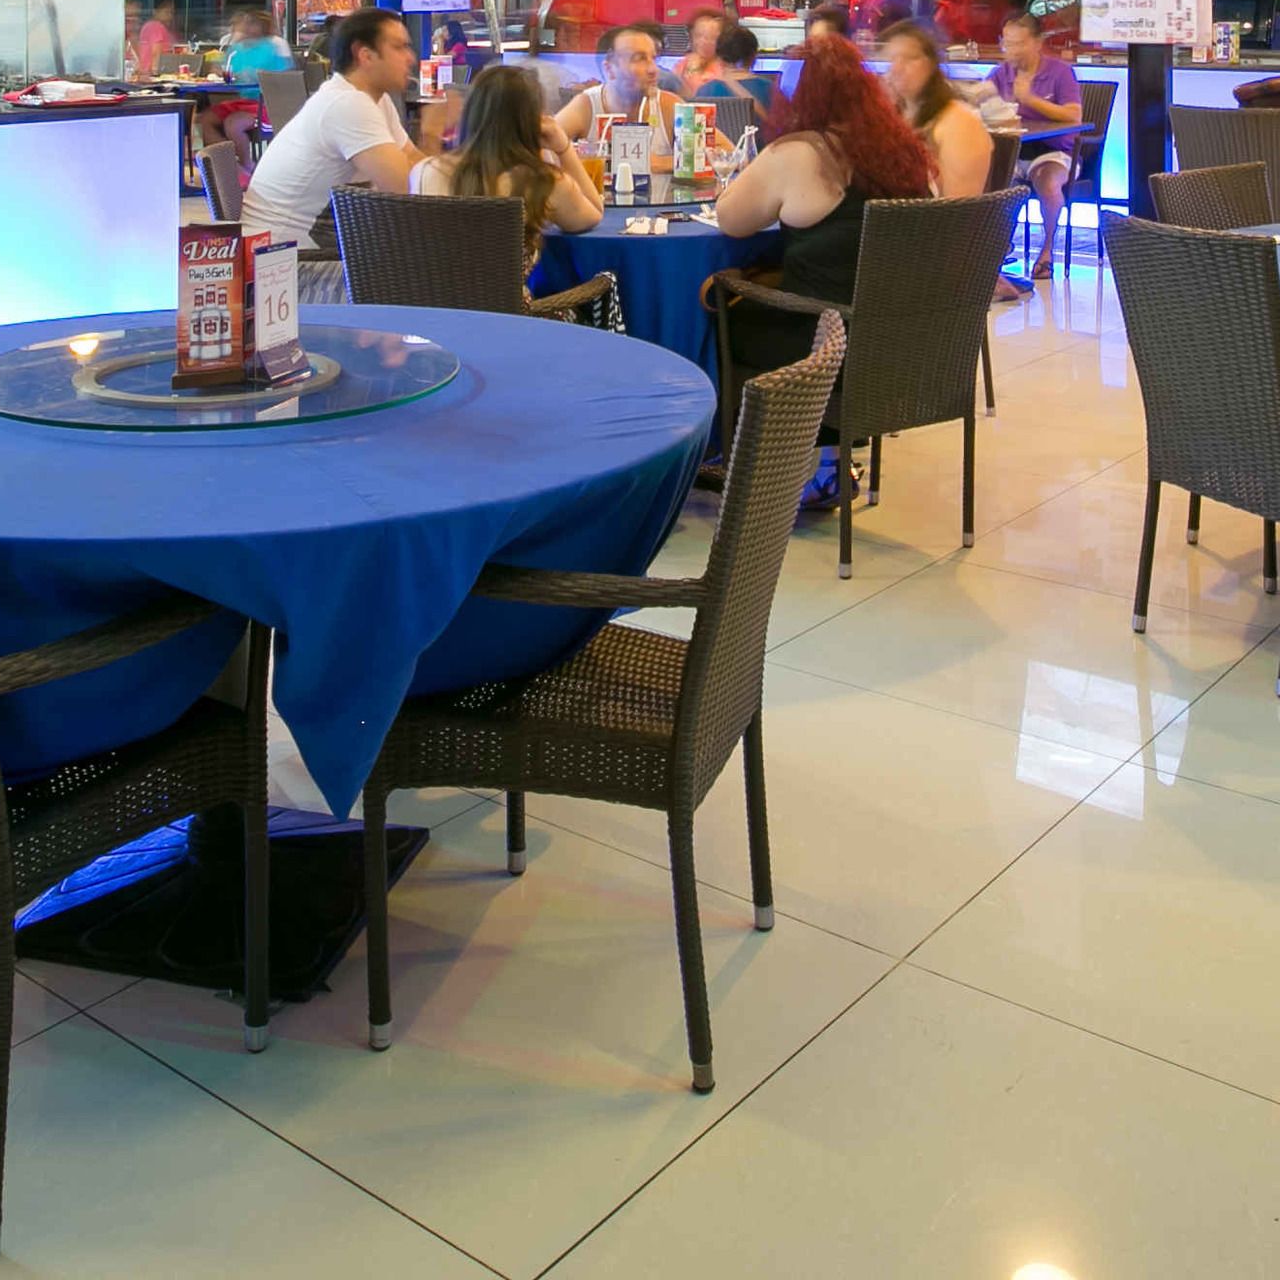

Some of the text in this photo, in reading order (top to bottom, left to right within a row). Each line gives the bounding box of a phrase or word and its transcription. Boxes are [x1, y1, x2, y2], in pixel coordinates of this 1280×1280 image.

[620, 142, 643, 160] 14
[183, 237, 238, 261] Deal
[263, 289, 290, 326] 16
